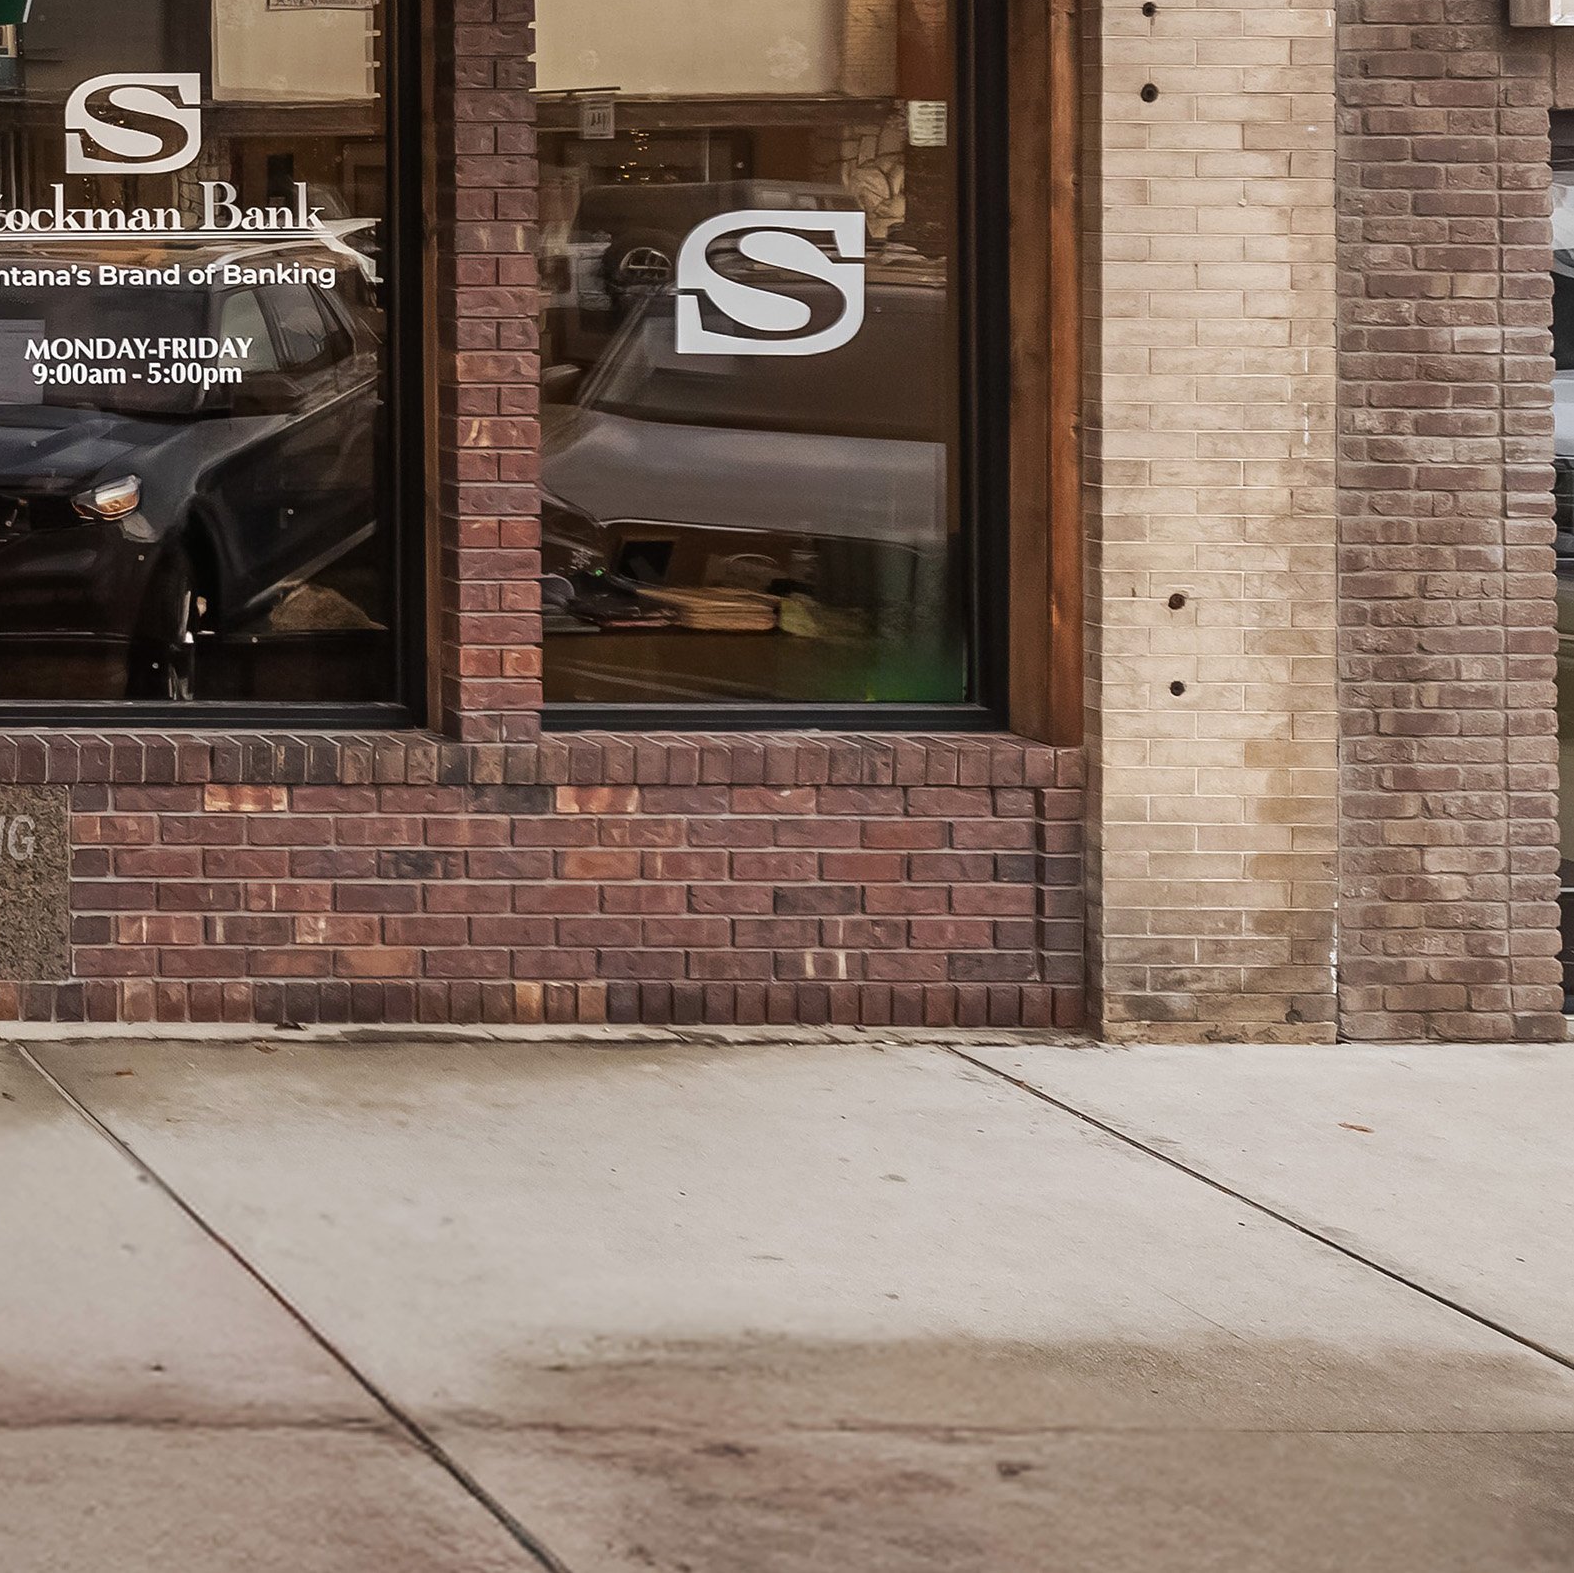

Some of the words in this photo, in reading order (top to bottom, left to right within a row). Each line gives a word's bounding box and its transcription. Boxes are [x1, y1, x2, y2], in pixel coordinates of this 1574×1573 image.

[198, 181, 326, 232] Bank
[99, 264, 181, 286] Brand
[188, 263, 217, 286] of
[223, 262, 337, 289] Banking
[24, 337, 254, 361] MONDAY-FRIDAY
[32, 363, 128, 386] 9:00am
[147, 362, 243, 390] 5:00pm
